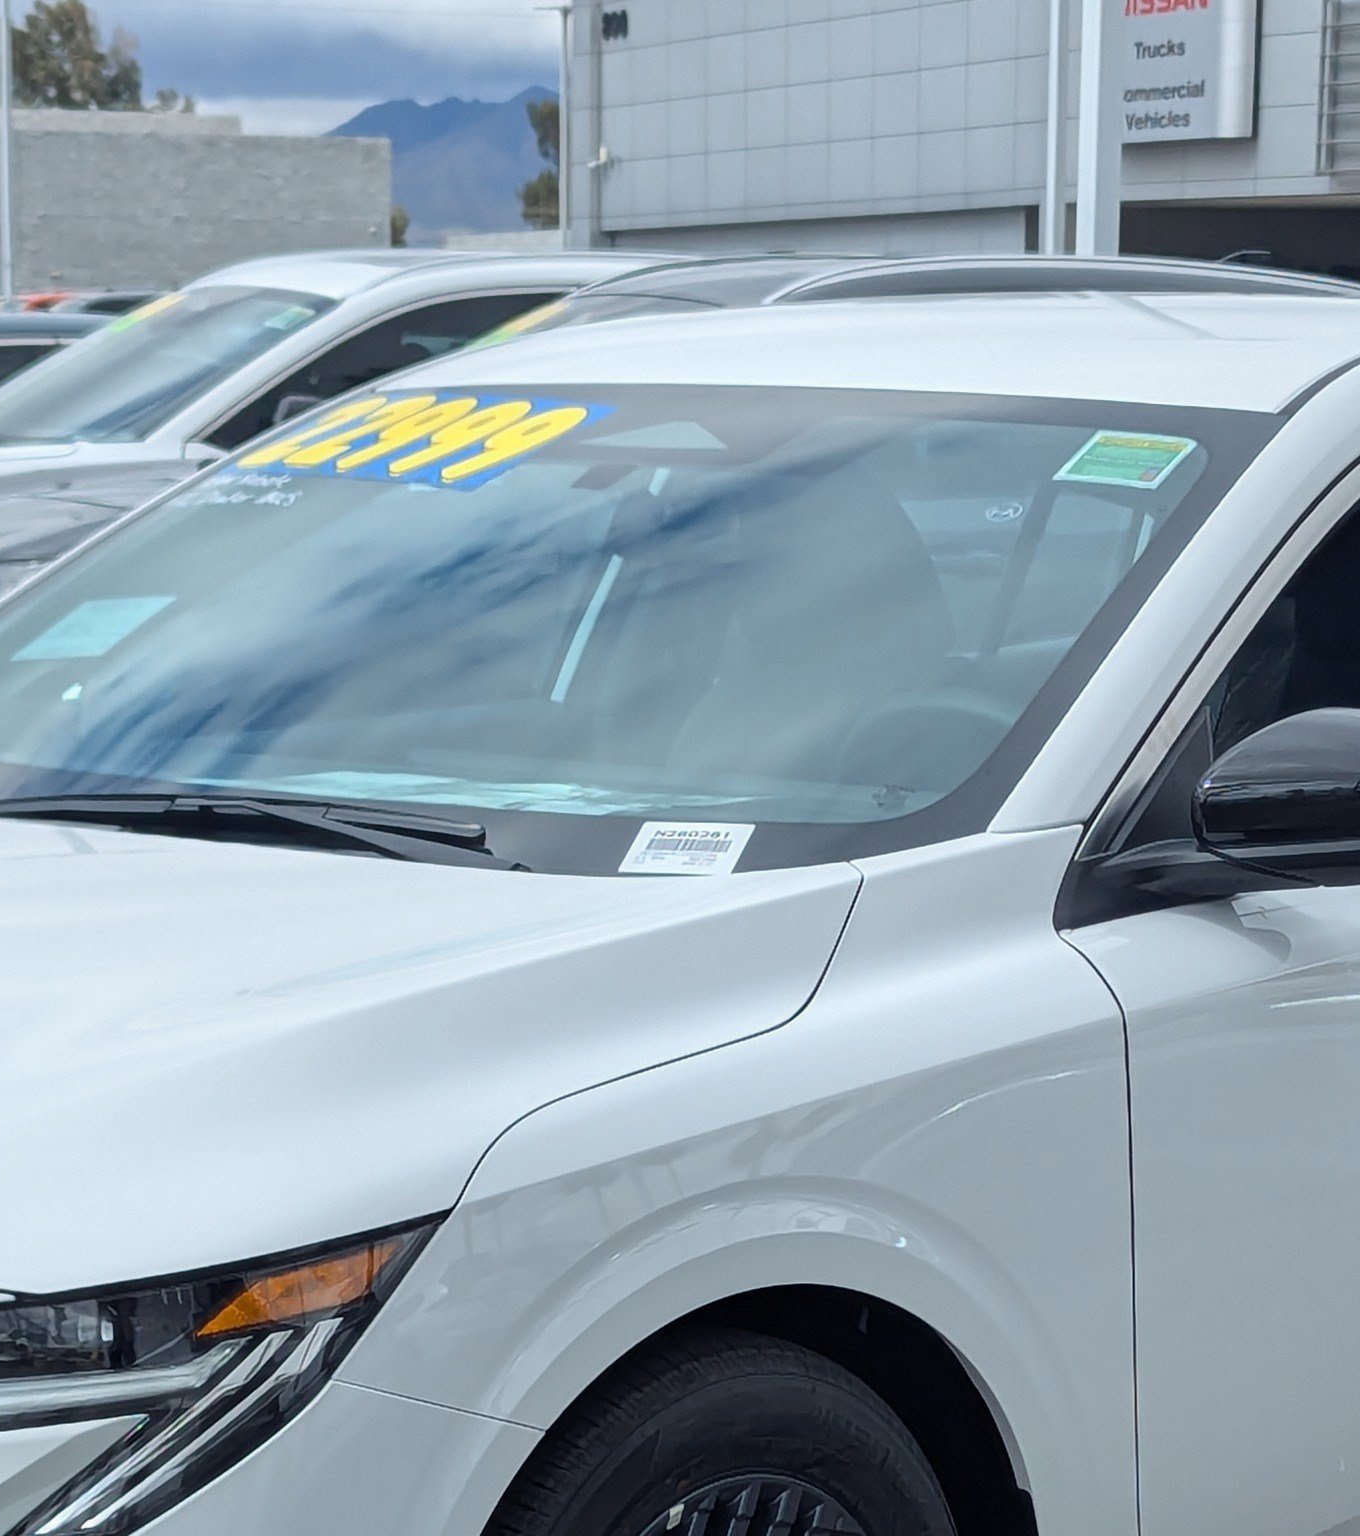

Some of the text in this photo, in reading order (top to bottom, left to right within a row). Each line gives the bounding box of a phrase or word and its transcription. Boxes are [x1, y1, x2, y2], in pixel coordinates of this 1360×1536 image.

[1134, 39, 1186, 60] Trucks
[1123, 79, 1206, 102] ommercial
[1125, 111, 1191, 131] Vehicles
